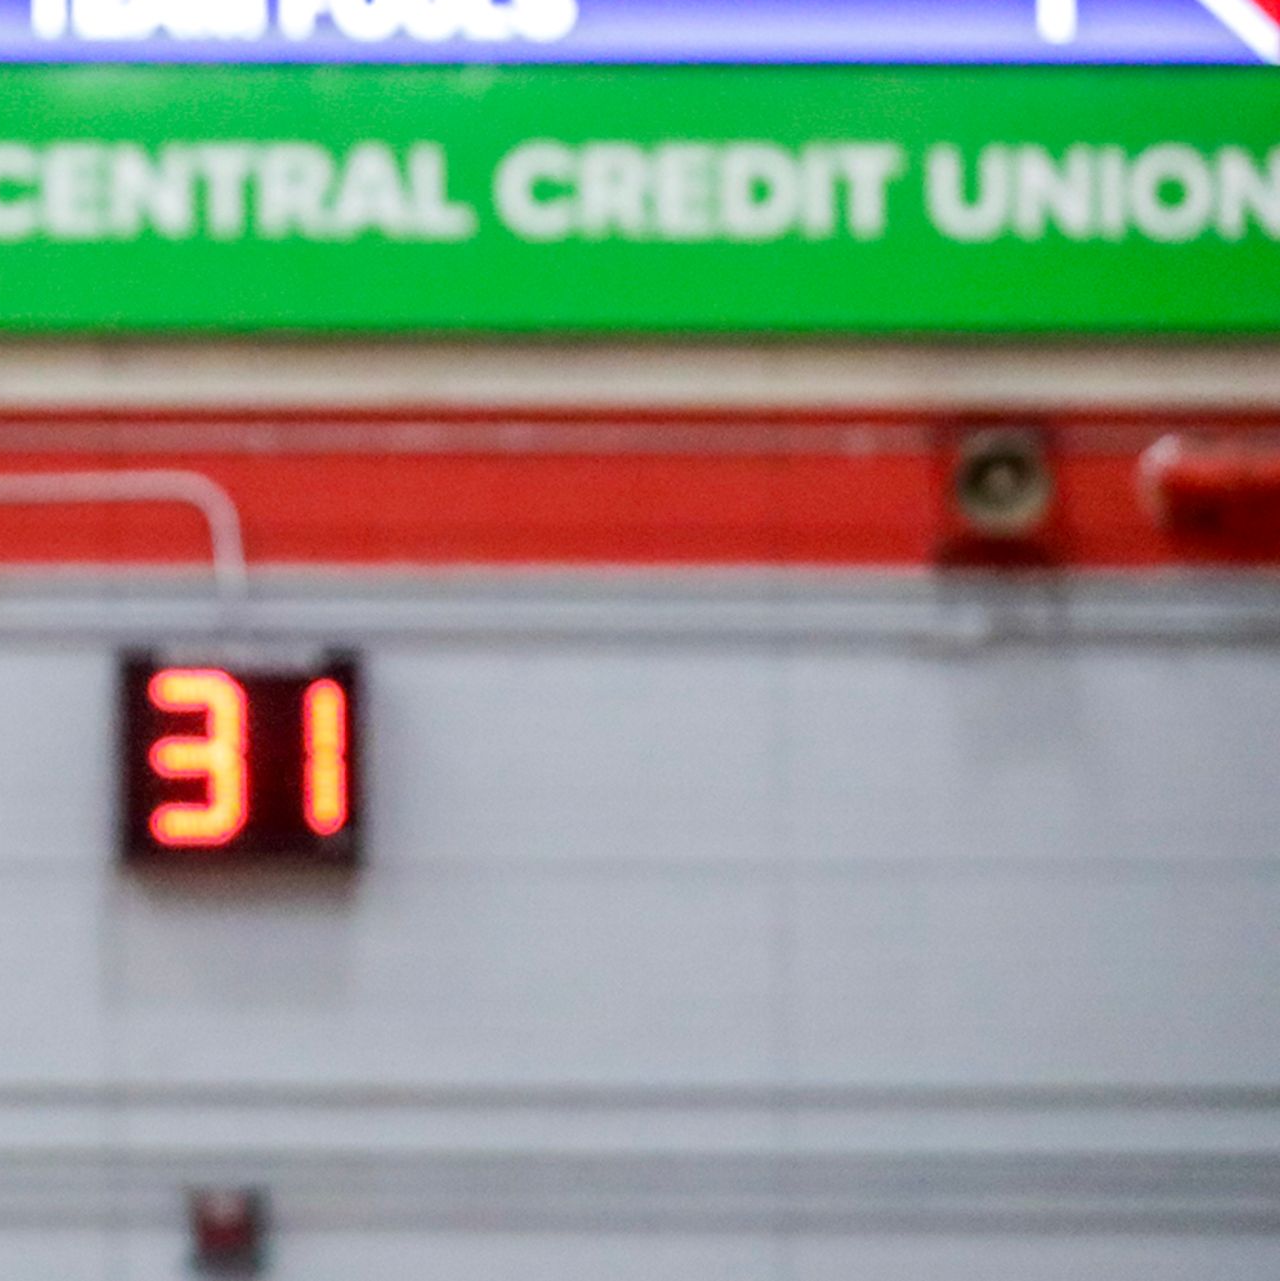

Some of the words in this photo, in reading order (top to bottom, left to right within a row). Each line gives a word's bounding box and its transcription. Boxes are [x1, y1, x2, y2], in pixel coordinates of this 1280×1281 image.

[493, 138, 905, 243] CREDIT
[925, 140, 1280, 244] UNION
[148, 668, 348, 846] 31
